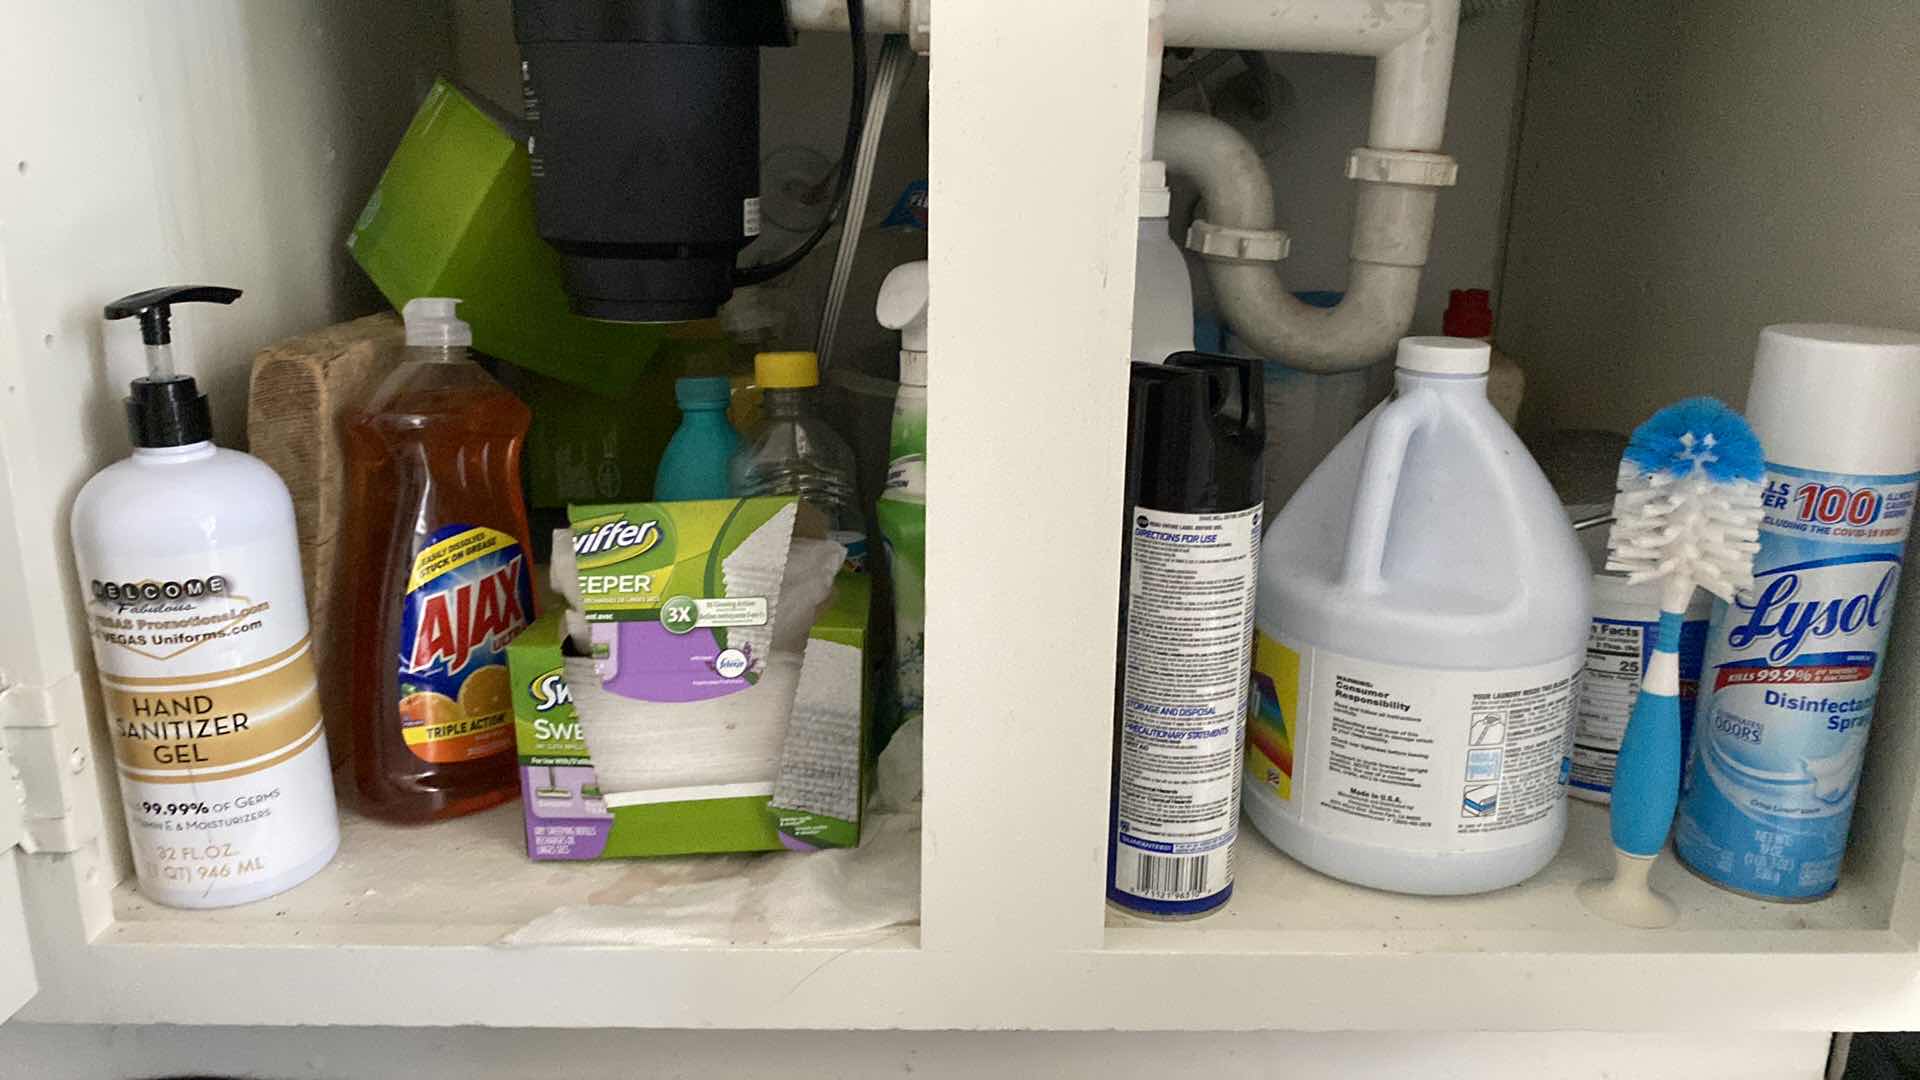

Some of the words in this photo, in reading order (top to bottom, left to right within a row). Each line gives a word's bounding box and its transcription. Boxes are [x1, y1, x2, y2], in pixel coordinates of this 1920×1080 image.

[1795, 482, 1883, 527] 100
[1135, 527, 1181, 543] DIRECTIONS
[1181, 534, 1200, 544] FOR
[1200, 533, 1218, 543] USE
[1810, 525, 1832, 536] THE
[117, 602, 198, 615] Fabulous
[136, 601, 271, 632] Promotional.com
[409, 553, 523, 676] AJAX
[667, 606, 692, 623] 3X
[1728, 565, 1898, 662] Lysol
[152, 619, 264, 646] Uniforms.com
[1601, 624, 1640, 637] Facts
[1619, 661, 1640, 673] 25
[1727, 672, 1756, 683] KILLS
[1756, 668, 1812, 683] 99.9%
[1335, 681, 1390, 699] Consumer
[132, 695, 214, 717] HAND
[1335, 689, 1411, 712] Responsibility
[1160, 706, 1178, 717] AND
[1178, 706, 1217, 717] DISPOSAL
[116, 712, 250, 741] SANITIZER
[426, 721, 469, 740] TRIPLE
[1187, 726, 1229, 740] STATEMENTS
[153, 743, 209, 764] GEL
[1350, 787, 1370, 798] Made
[142, 801, 209, 816] 99.99%
[212, 802, 231, 813] OF
[185, 808, 273, 831] MOISTURIZERS
[199, 864, 232, 881] 946
